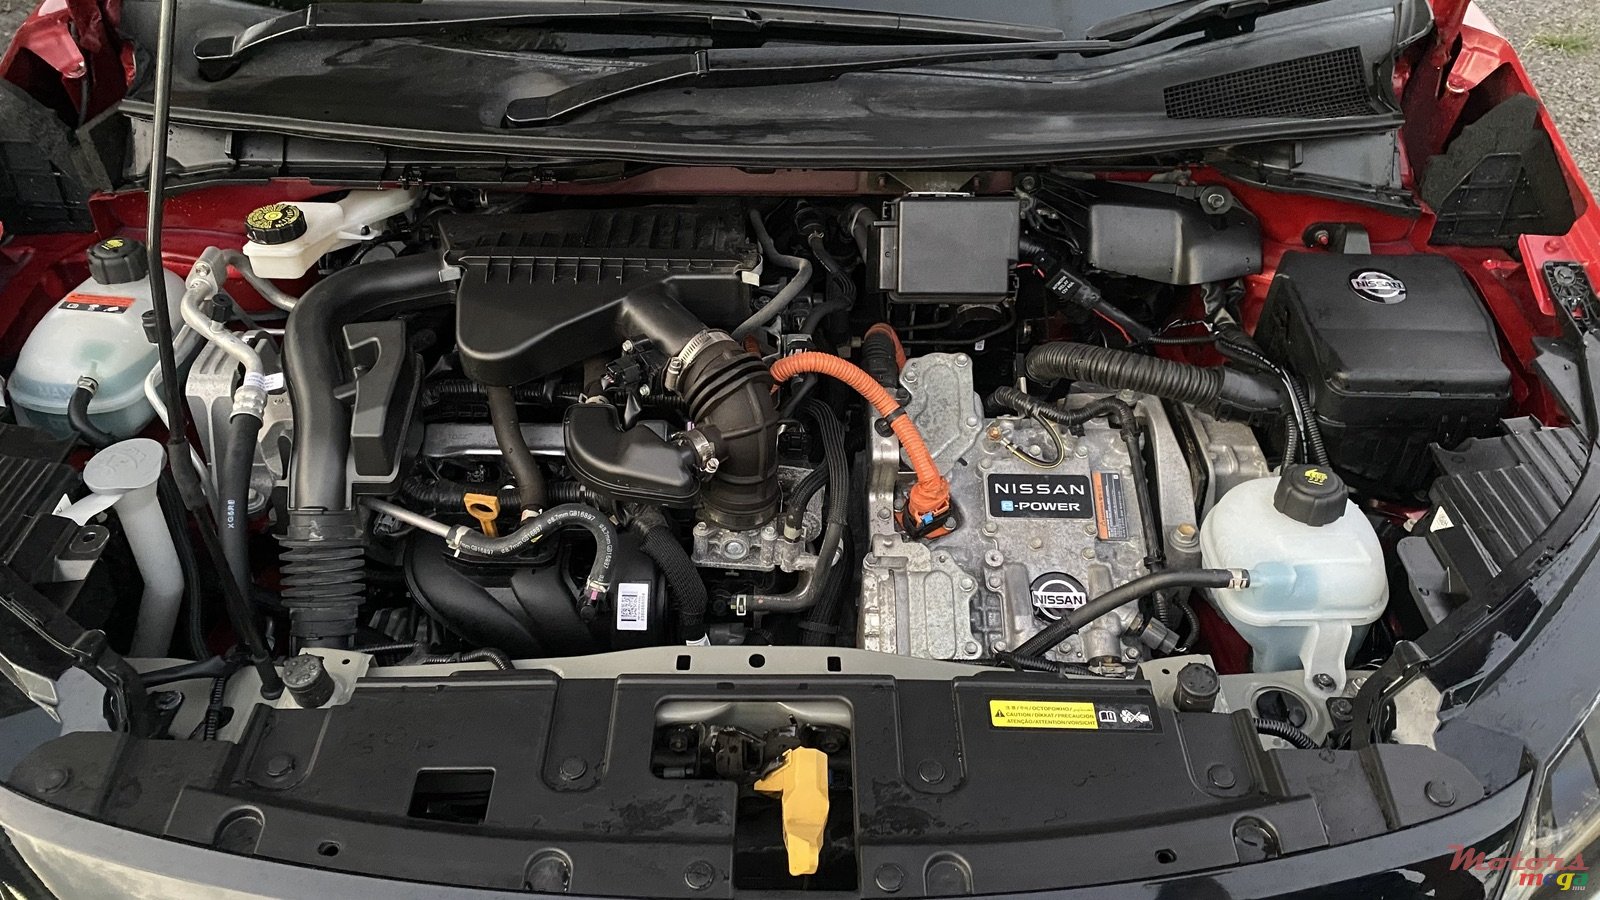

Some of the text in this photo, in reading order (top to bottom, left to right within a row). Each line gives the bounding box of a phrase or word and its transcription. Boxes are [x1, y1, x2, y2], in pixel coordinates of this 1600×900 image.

[1355, 280, 1402, 289] NISSAN
[994, 483, 1085, 495] NISSAN
[1033, 594, 1083, 605] NISSAN
